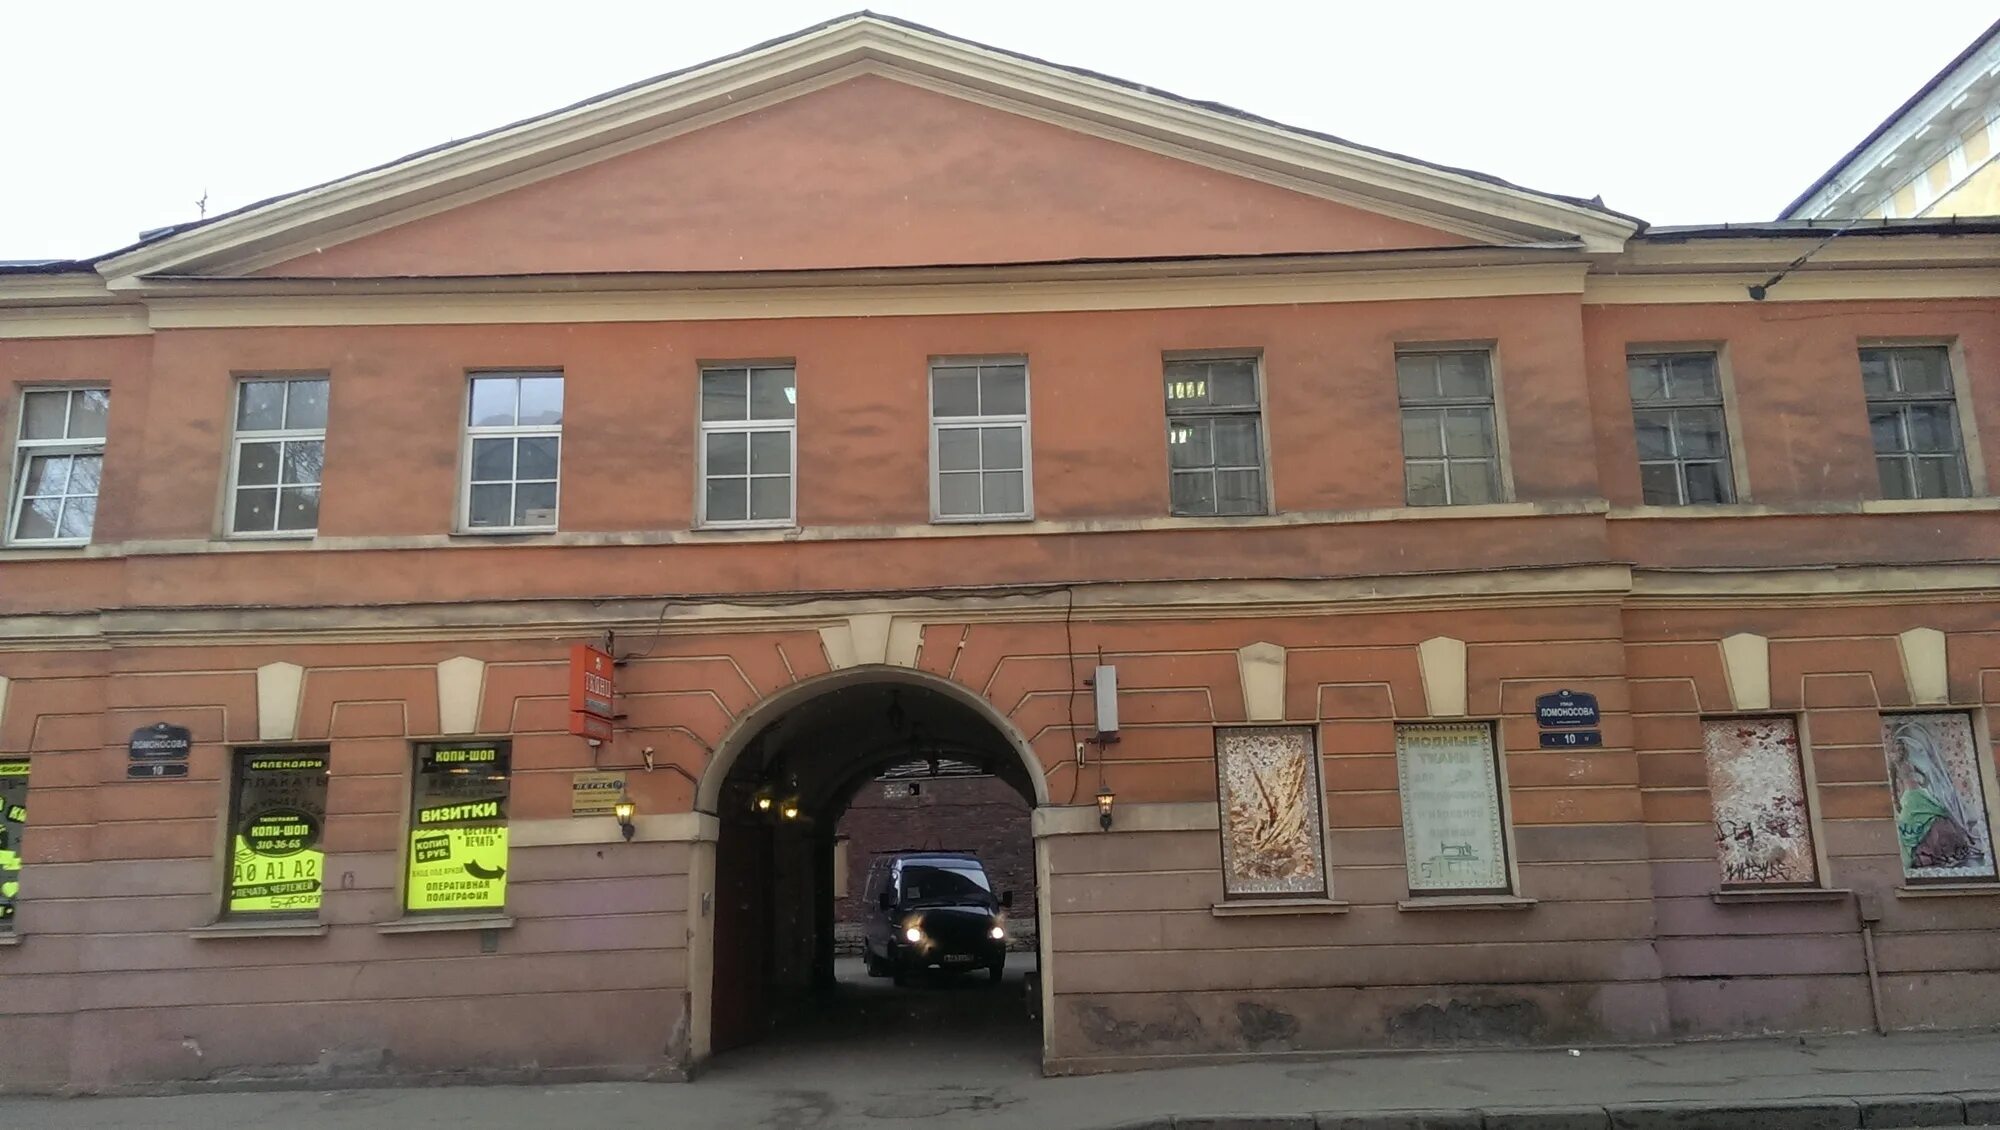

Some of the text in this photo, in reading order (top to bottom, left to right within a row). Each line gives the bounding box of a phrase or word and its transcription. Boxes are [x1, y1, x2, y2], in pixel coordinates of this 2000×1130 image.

[1541, 707, 1594, 717] ЛОМОНОСОВА
[1408, 736, 1478, 748] МОДНЫЕ
[1564, 733, 1576, 744] 10
[436, 750, 495, 762] КОПИ-ШОП
[152, 765, 164, 775] 10
[421, 802, 497, 822] ВИЗИТКИ
[252, 824, 309, 837] КОПИ-ШОП
[256, 840, 301, 849] 310-36-65
[465, 836, 494, 847] ПЕЧАТЬ
[418, 849, 449, 860] 5 РУБ.
[236, 881, 314, 897] ПЕЧАТЬ ЧЕРТЕЖЕЙ
[426, 881, 490, 891] ОПЕРАТИВНАЯ
[426, 891, 489, 902] ПОЛИГРАФИЯ
